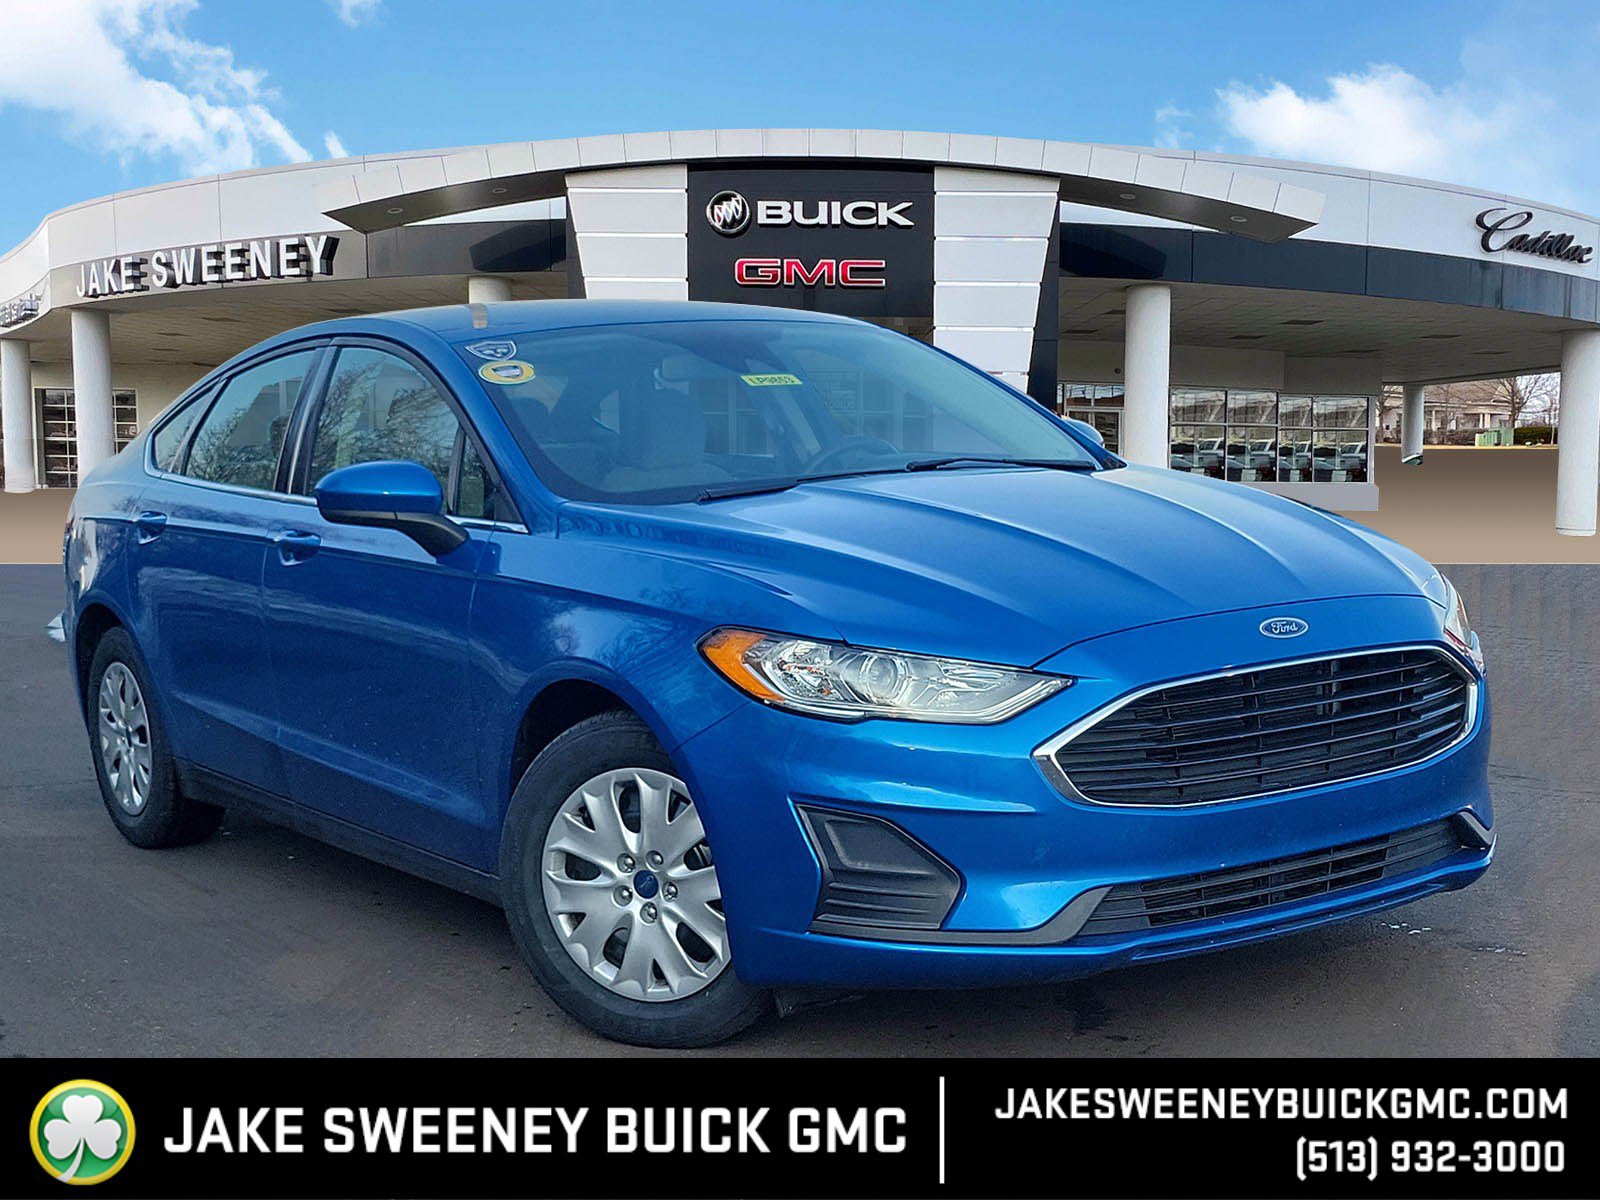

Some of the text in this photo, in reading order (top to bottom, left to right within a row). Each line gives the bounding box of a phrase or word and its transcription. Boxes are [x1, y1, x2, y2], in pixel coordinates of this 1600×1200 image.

[757, 200, 914, 226] BUICK
[1475, 207, 1594, 264] Cadillac
[76, 235, 332, 298] JAKE SWEENEY
[735, 258, 886, 287] GMC
